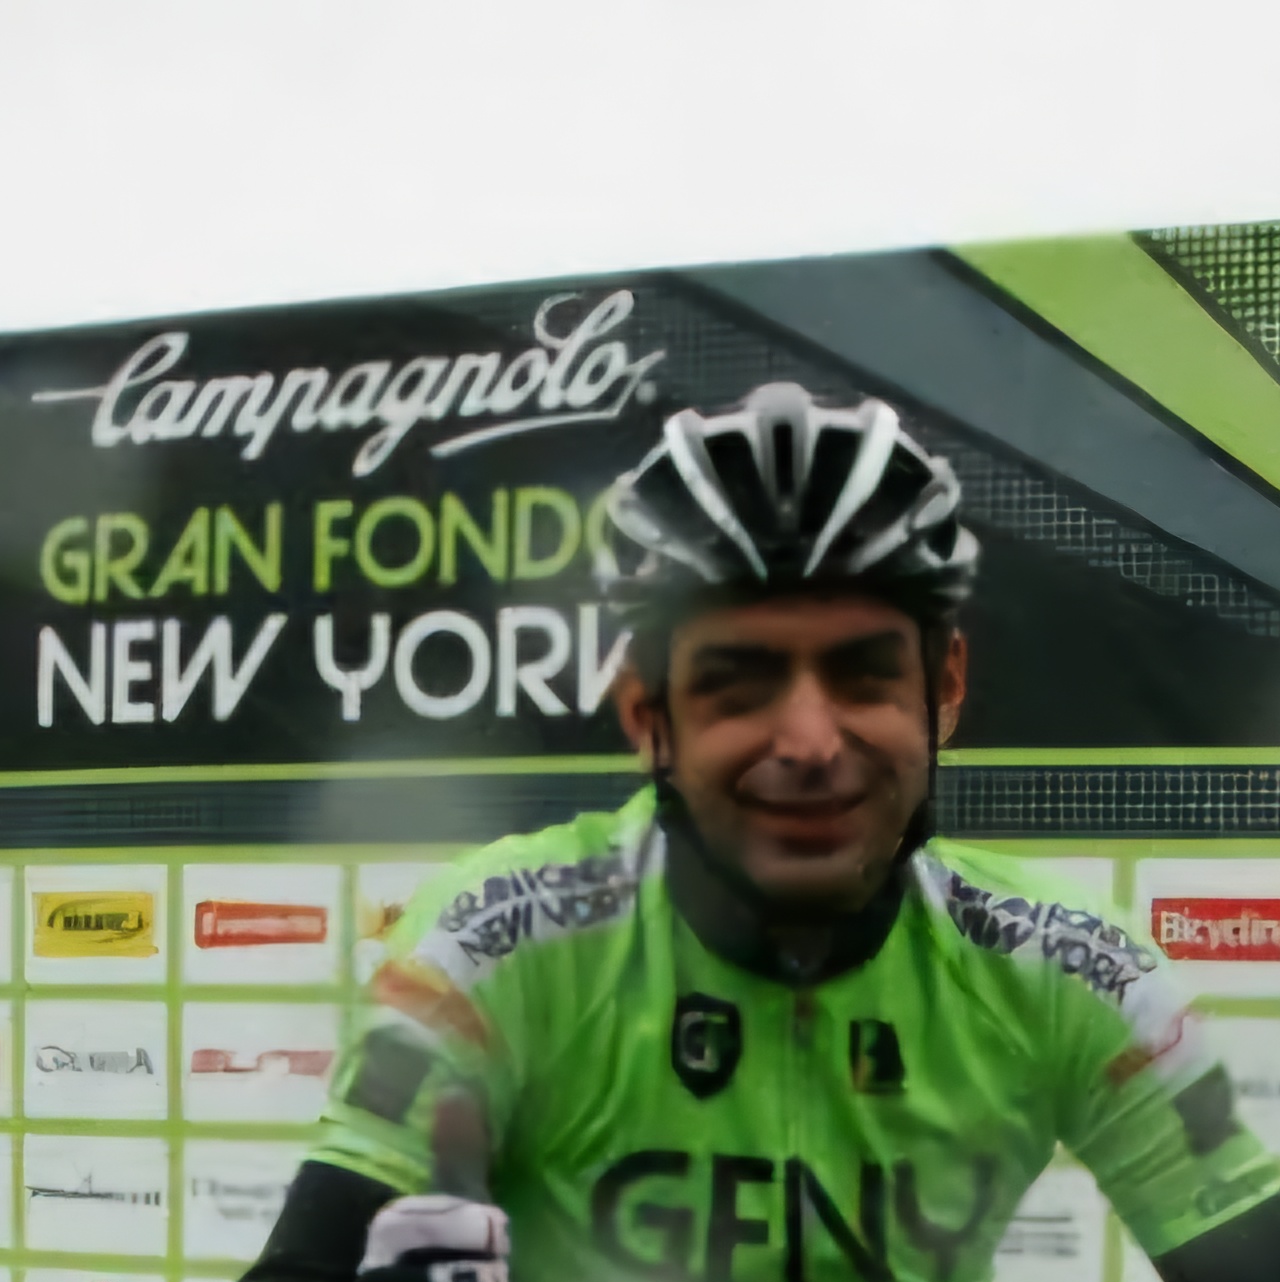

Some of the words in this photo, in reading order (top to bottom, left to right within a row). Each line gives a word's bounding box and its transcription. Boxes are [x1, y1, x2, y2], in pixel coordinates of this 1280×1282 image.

[32, 288, 666, 478] Campagnolo
[38, 502, 284, 606] GRAN
[35, 612, 286, 728] NEW
